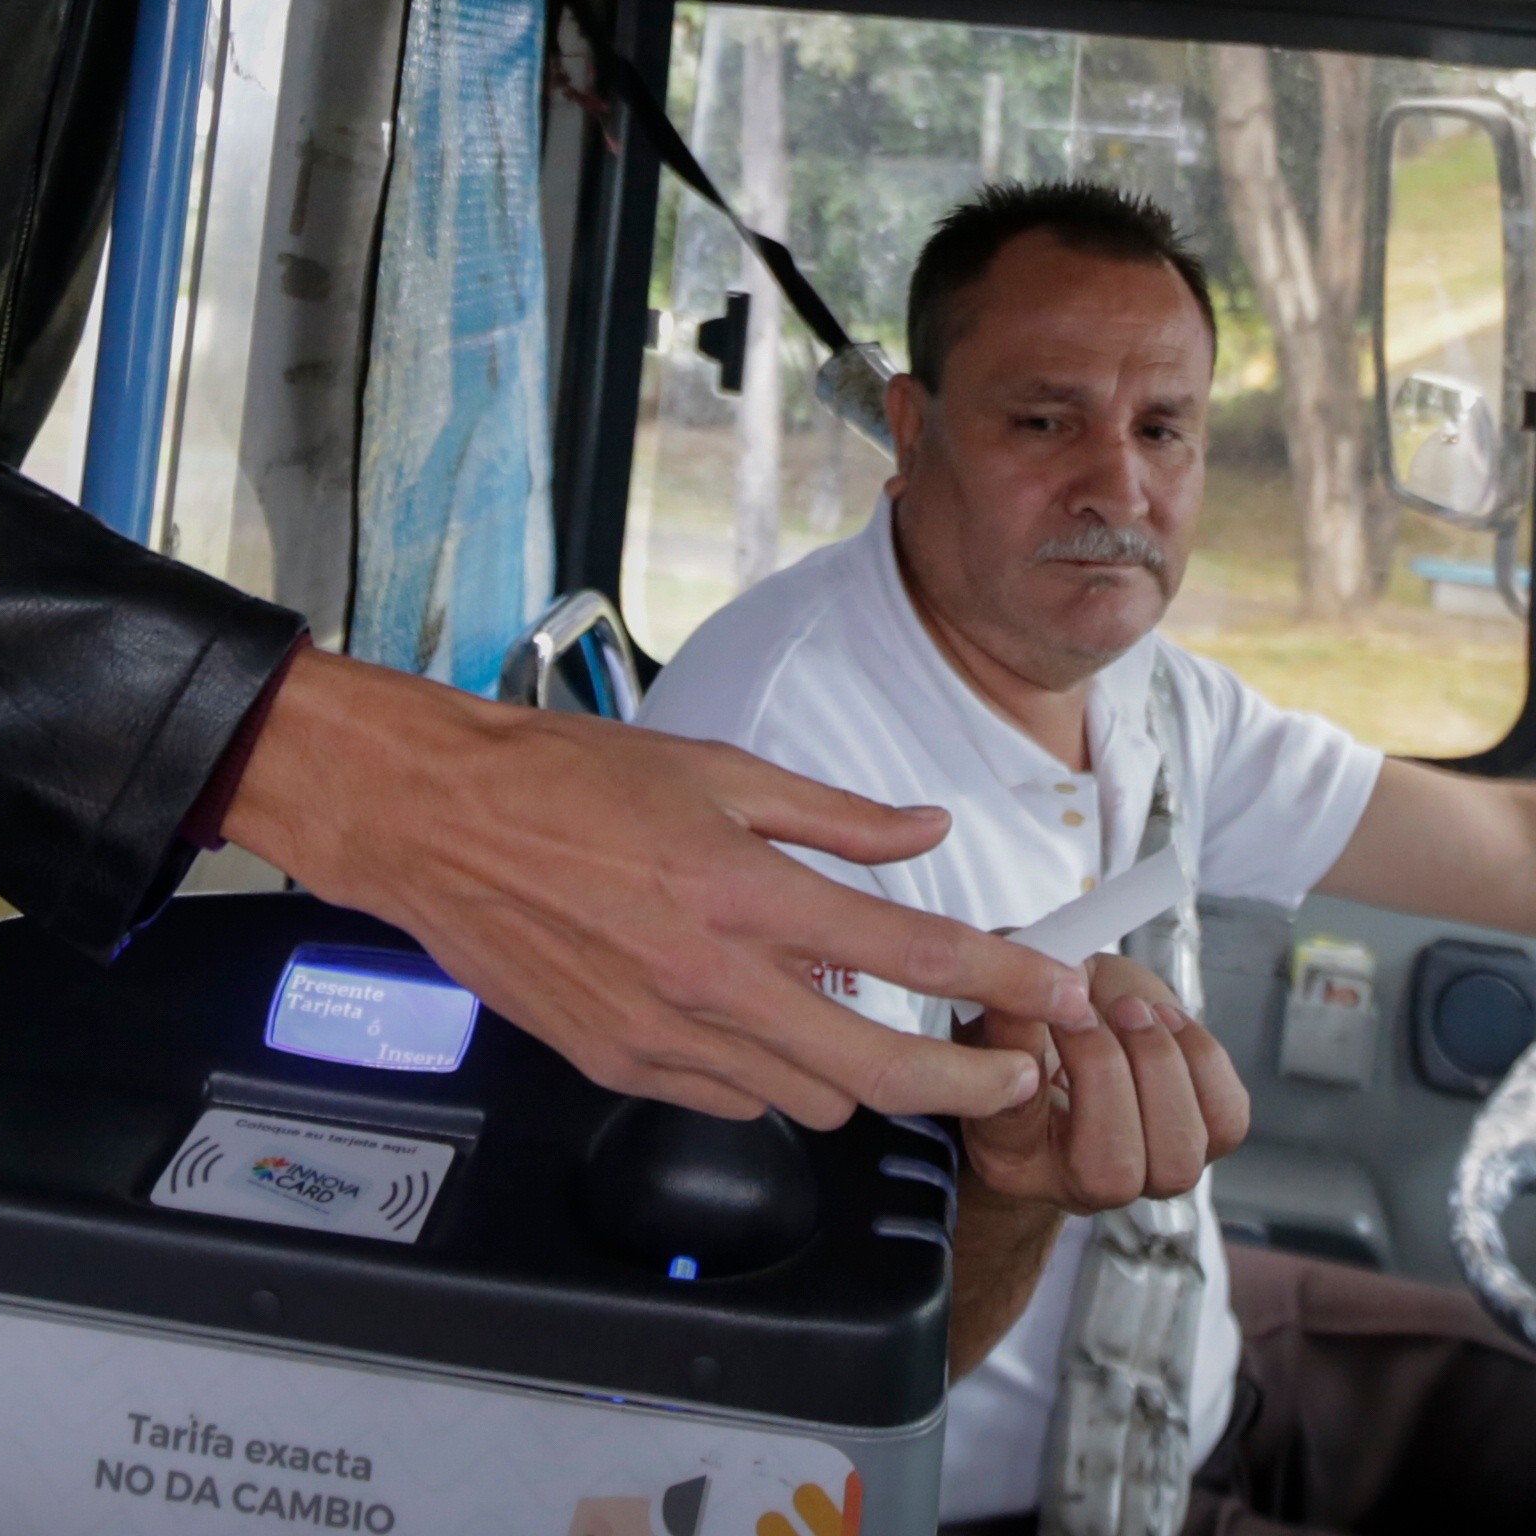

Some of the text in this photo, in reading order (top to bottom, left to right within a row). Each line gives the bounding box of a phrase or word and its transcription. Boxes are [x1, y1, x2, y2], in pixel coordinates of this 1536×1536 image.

[289, 973, 386, 1004] Presente
[286, 992, 363, 1021] Tarjeta
[375, 1042, 457, 1067] Inserte
[234, 1117, 301, 1138] Coloque
[304, 1129, 326, 1141] su
[328, 1133, 380, 1151] tarjeta
[274, 1175, 336, 1205] CARD
[284, 1162, 362, 1199] INNOVA
[127, 1411, 375, 1483] Tarifa exacta
[94, 1457, 396, 1535] NO DA CAMBIO
